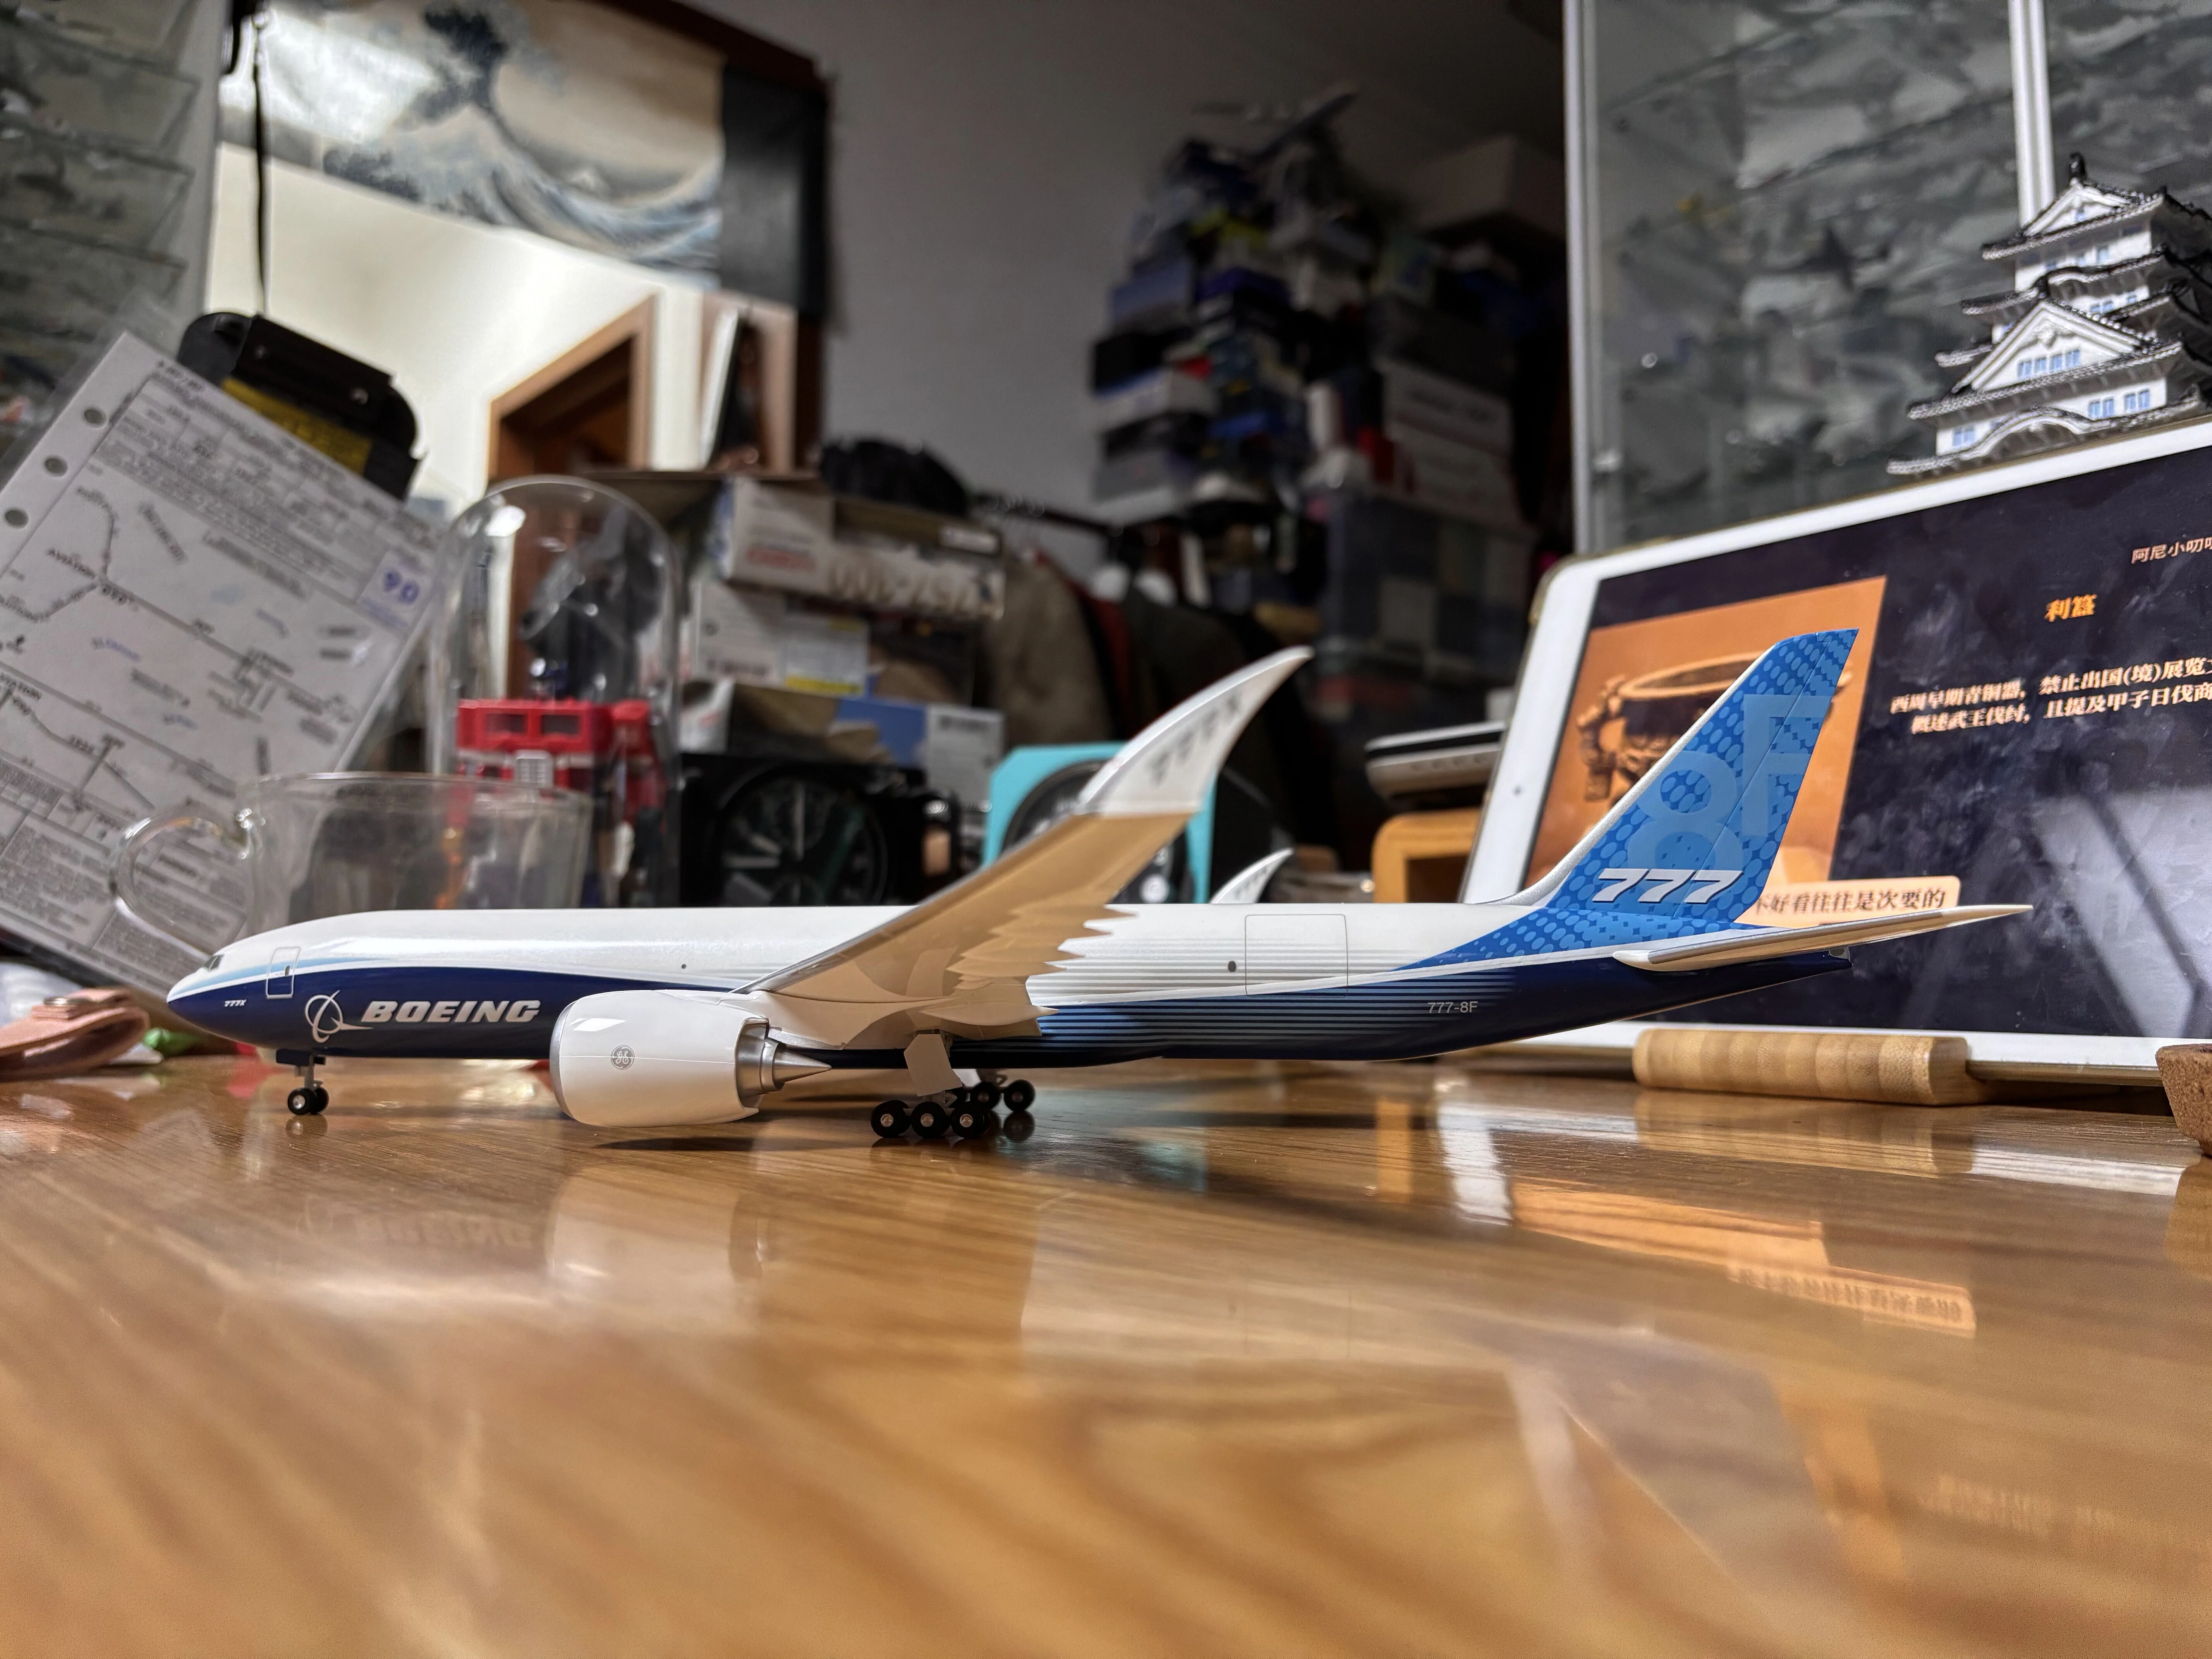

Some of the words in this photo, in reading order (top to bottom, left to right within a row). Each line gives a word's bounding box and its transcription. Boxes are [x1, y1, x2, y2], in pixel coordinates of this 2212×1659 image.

[1890, 657, 2212, 714] 西周早期青铜器，禁止出国(境)展览
[1592, 868, 1743, 904] 777
[224, 999, 247, 1007] 777X
[361, 1000, 541, 1022] BOEING
[1427, 1001, 1478, 1013] 777-8F
